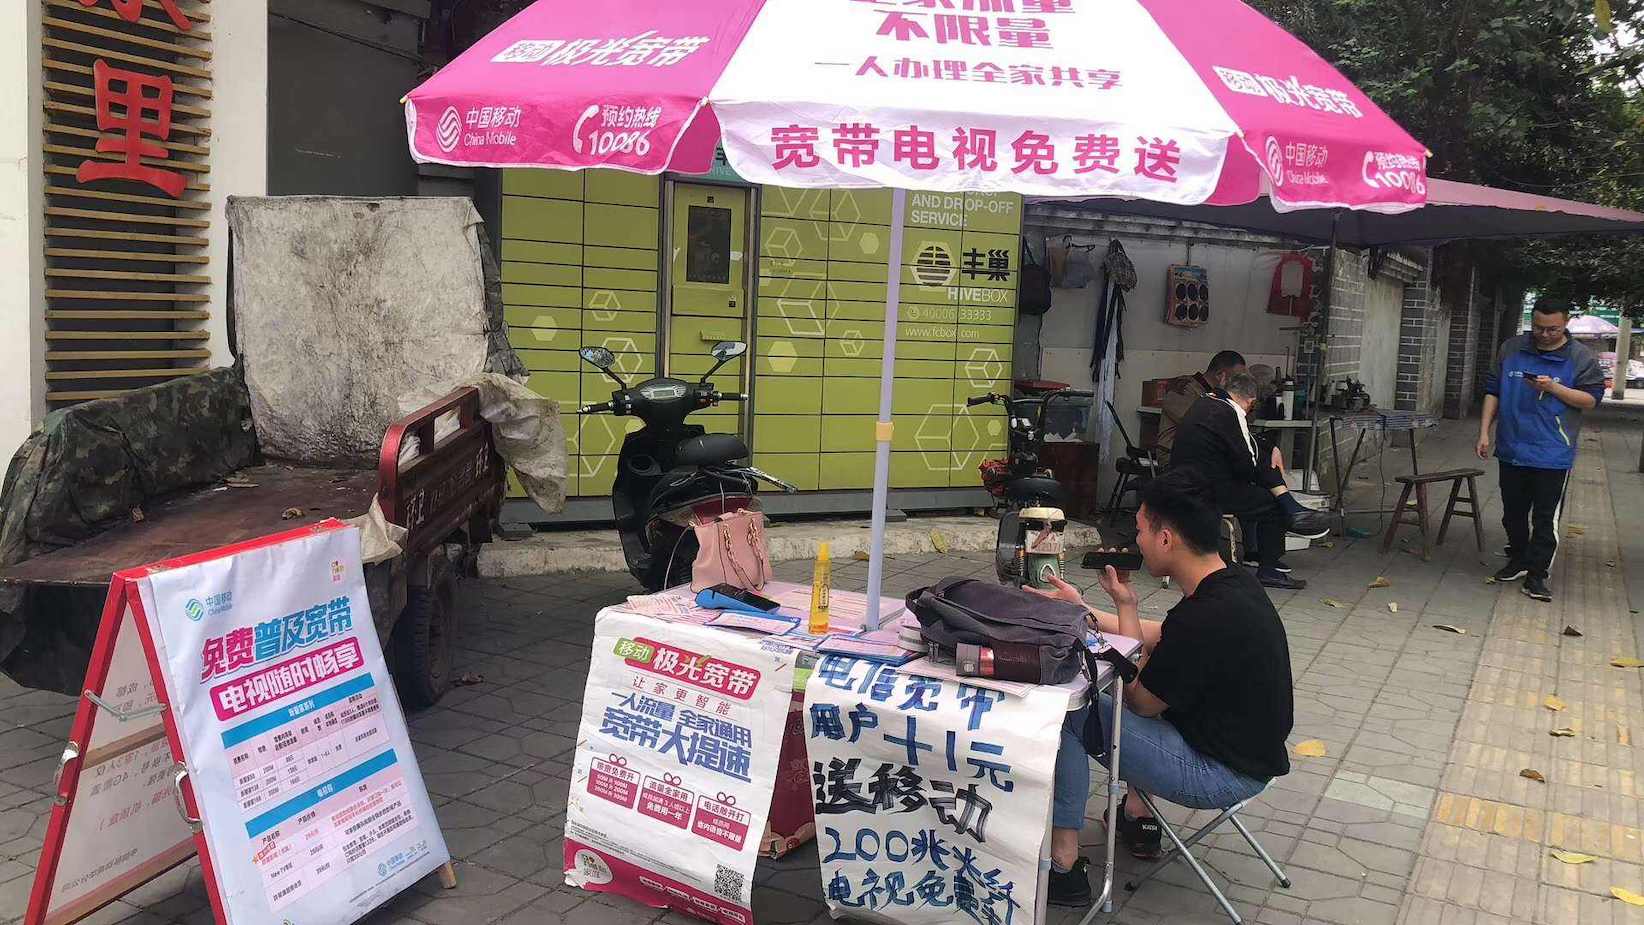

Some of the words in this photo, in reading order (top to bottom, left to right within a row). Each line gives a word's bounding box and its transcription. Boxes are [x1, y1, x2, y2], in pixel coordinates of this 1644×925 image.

[873, 10, 1053, 49] 不限量
[814, 55, 1123, 90] 一人办理全家共享
[465, 106, 521, 129] 中国移动
[601, 104, 661, 128] 预约热线
[464, 131, 485, 146] China
[486, 131, 517, 146] Mobile
[589, 130, 650, 156] 10086
[771, 122, 1184, 183] 宽带电视免费送
[1285, 141, 1328, 168] 中国移动
[1376, 172, 1425, 194] 10086
[911, 194, 941, 209] AND
[944, 196, 1014, 215] DROP-OFF
[911, 211, 968, 226] SERVICE
[962, 247, 1010, 281] 丰巢
[947, 288, 1008, 303] HIVEBOX
[201, 596, 353, 680] 免费普及宽带
[220, 641, 361, 714] 电视随时畅享
[618, 639, 649, 661] 移动
[653, 648, 758, 695] 极光宽带
[632, 675, 731, 715] 让家更智能
[611, 692, 676, 722] 一人流量
[679, 710, 752, 747] 全家通用
[599, 706, 752, 783] 宽带大提速
[814, 757, 992, 843] 送移动
